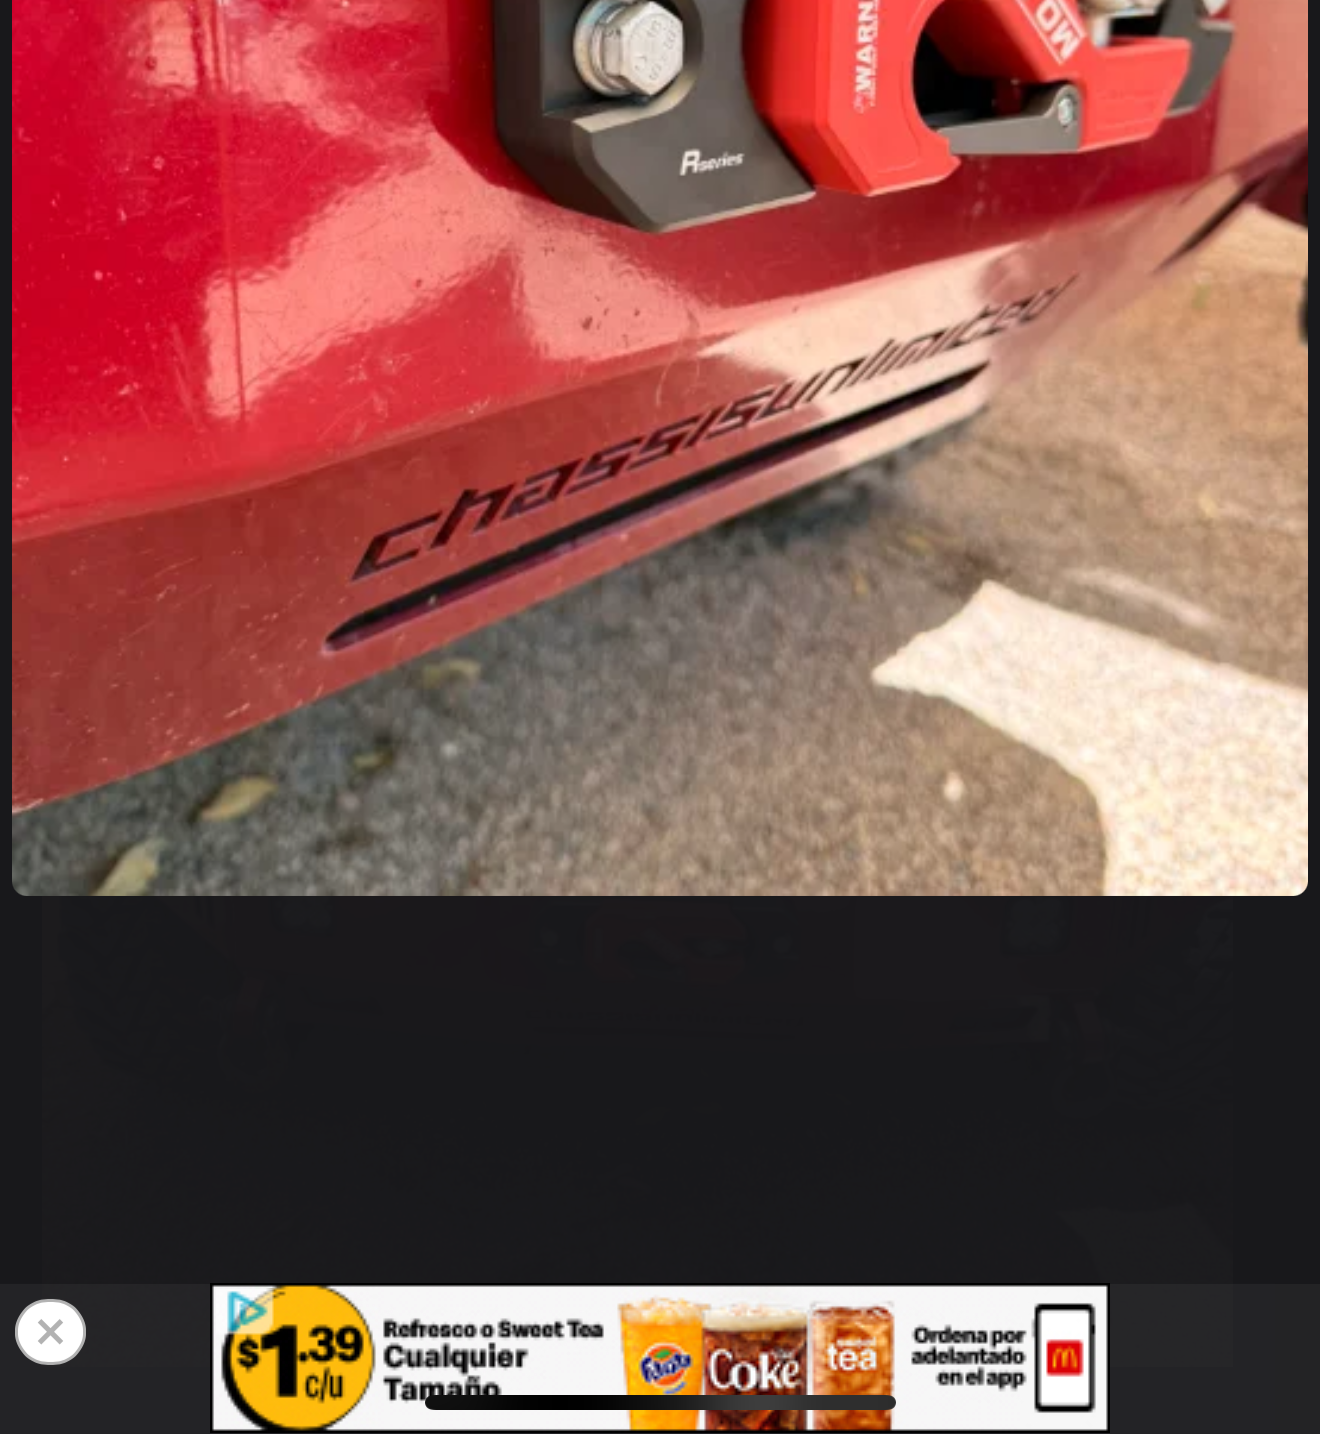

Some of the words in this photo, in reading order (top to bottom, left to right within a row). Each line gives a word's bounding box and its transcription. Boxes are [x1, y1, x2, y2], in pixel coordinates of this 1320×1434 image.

[384, 1319, 478, 1338] Refresco
[480, 1323, 495, 1338] o
[497, 1319, 564, 1338] Sweet
[567, 1319, 604, 1338] Tea
[913, 1325, 988, 1344] Ordena
[991, 1330, 1027, 1349] por
[384, 1342, 528, 1375] Cualquier
[826, 1343, 877, 1370] tea
[911, 1346, 1026, 1365] adelantado
[709, 1348, 801, 1391] Coke
[936, 1372, 963, 1386] en
[965, 1367, 984, 1386] el
[986, 1372, 1026, 1391] app
[305, 1367, 344, 1403] c/u
[384, 1375, 501, 1401] Tamaño
